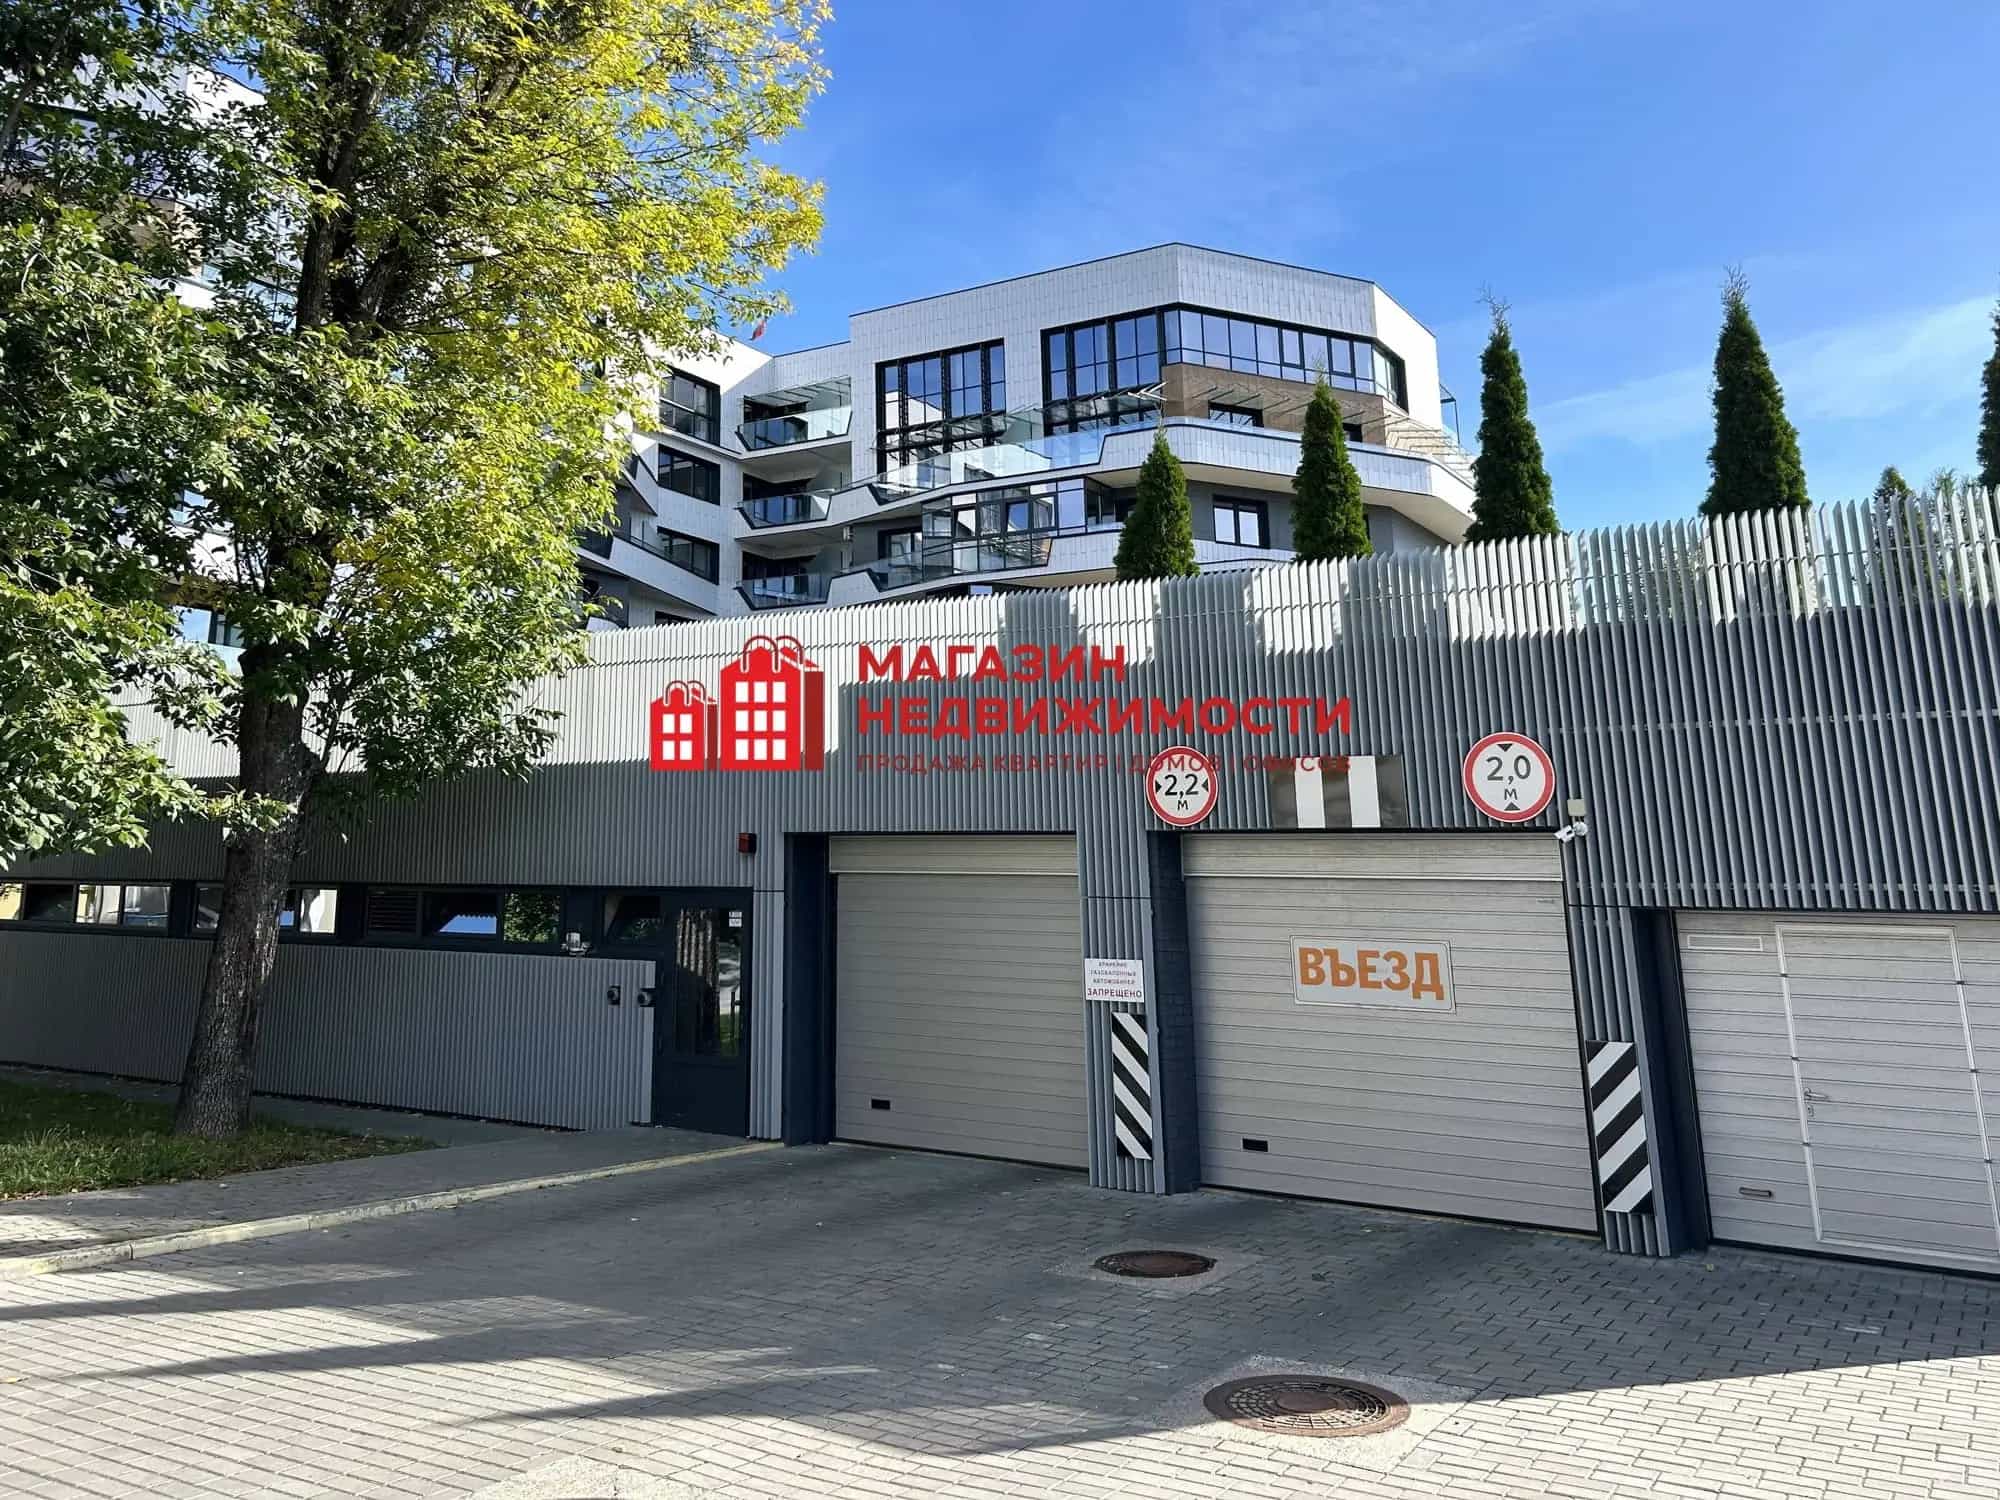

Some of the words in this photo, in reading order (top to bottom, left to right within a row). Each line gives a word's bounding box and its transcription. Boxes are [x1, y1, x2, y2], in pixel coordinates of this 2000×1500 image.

[1486, 755, 1531, 784] 2,0
[1164, 774, 1199, 798] 2,2
[1299, 947, 1444, 1001] ВЪЕЗД
[1087, 988, 1142, 999] ЗАПРЕЩЕНО
